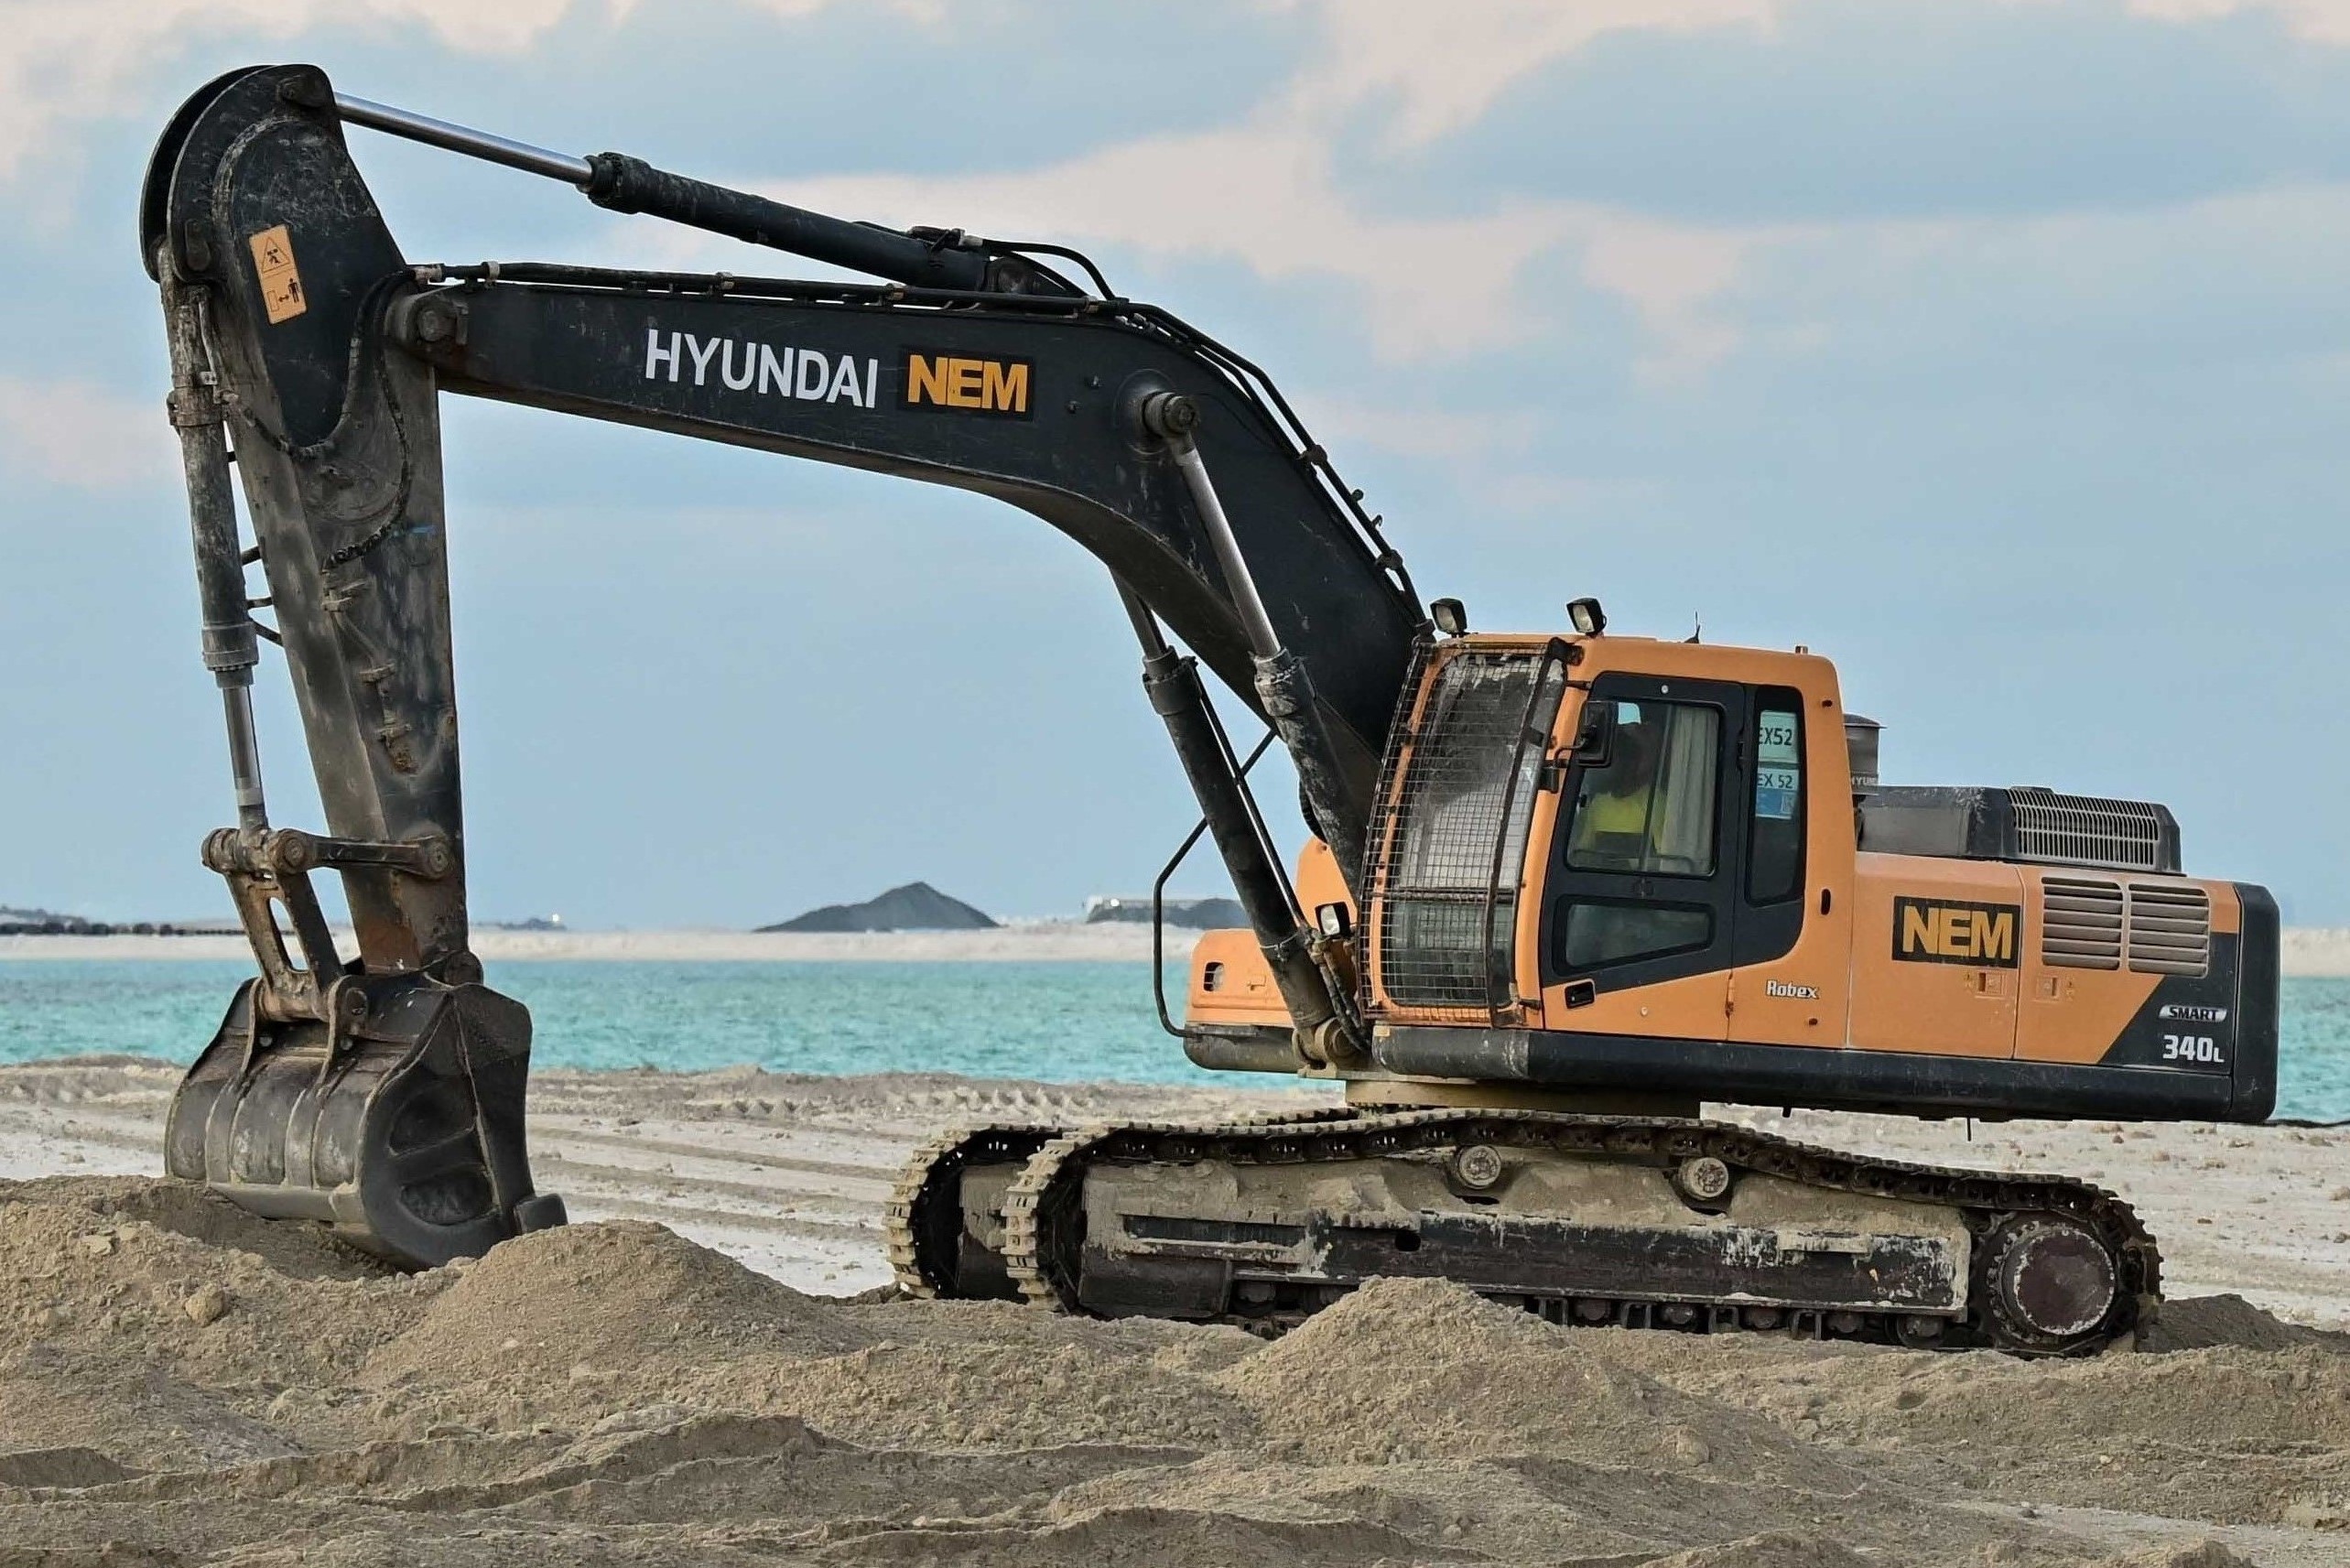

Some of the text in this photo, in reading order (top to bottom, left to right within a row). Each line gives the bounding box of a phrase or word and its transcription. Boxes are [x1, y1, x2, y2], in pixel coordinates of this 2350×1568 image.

[645, 328, 879, 408] HYUNDAI
[907, 353, 1028, 413] NEM
[1778, 774, 1793, 789] 52
[1902, 904, 2013, 960] NEM
[1766, 979, 1819, 1000] Robex
[2169, 1006, 2219, 1021] SMART
[2162, 1034, 2225, 1063] 340L
